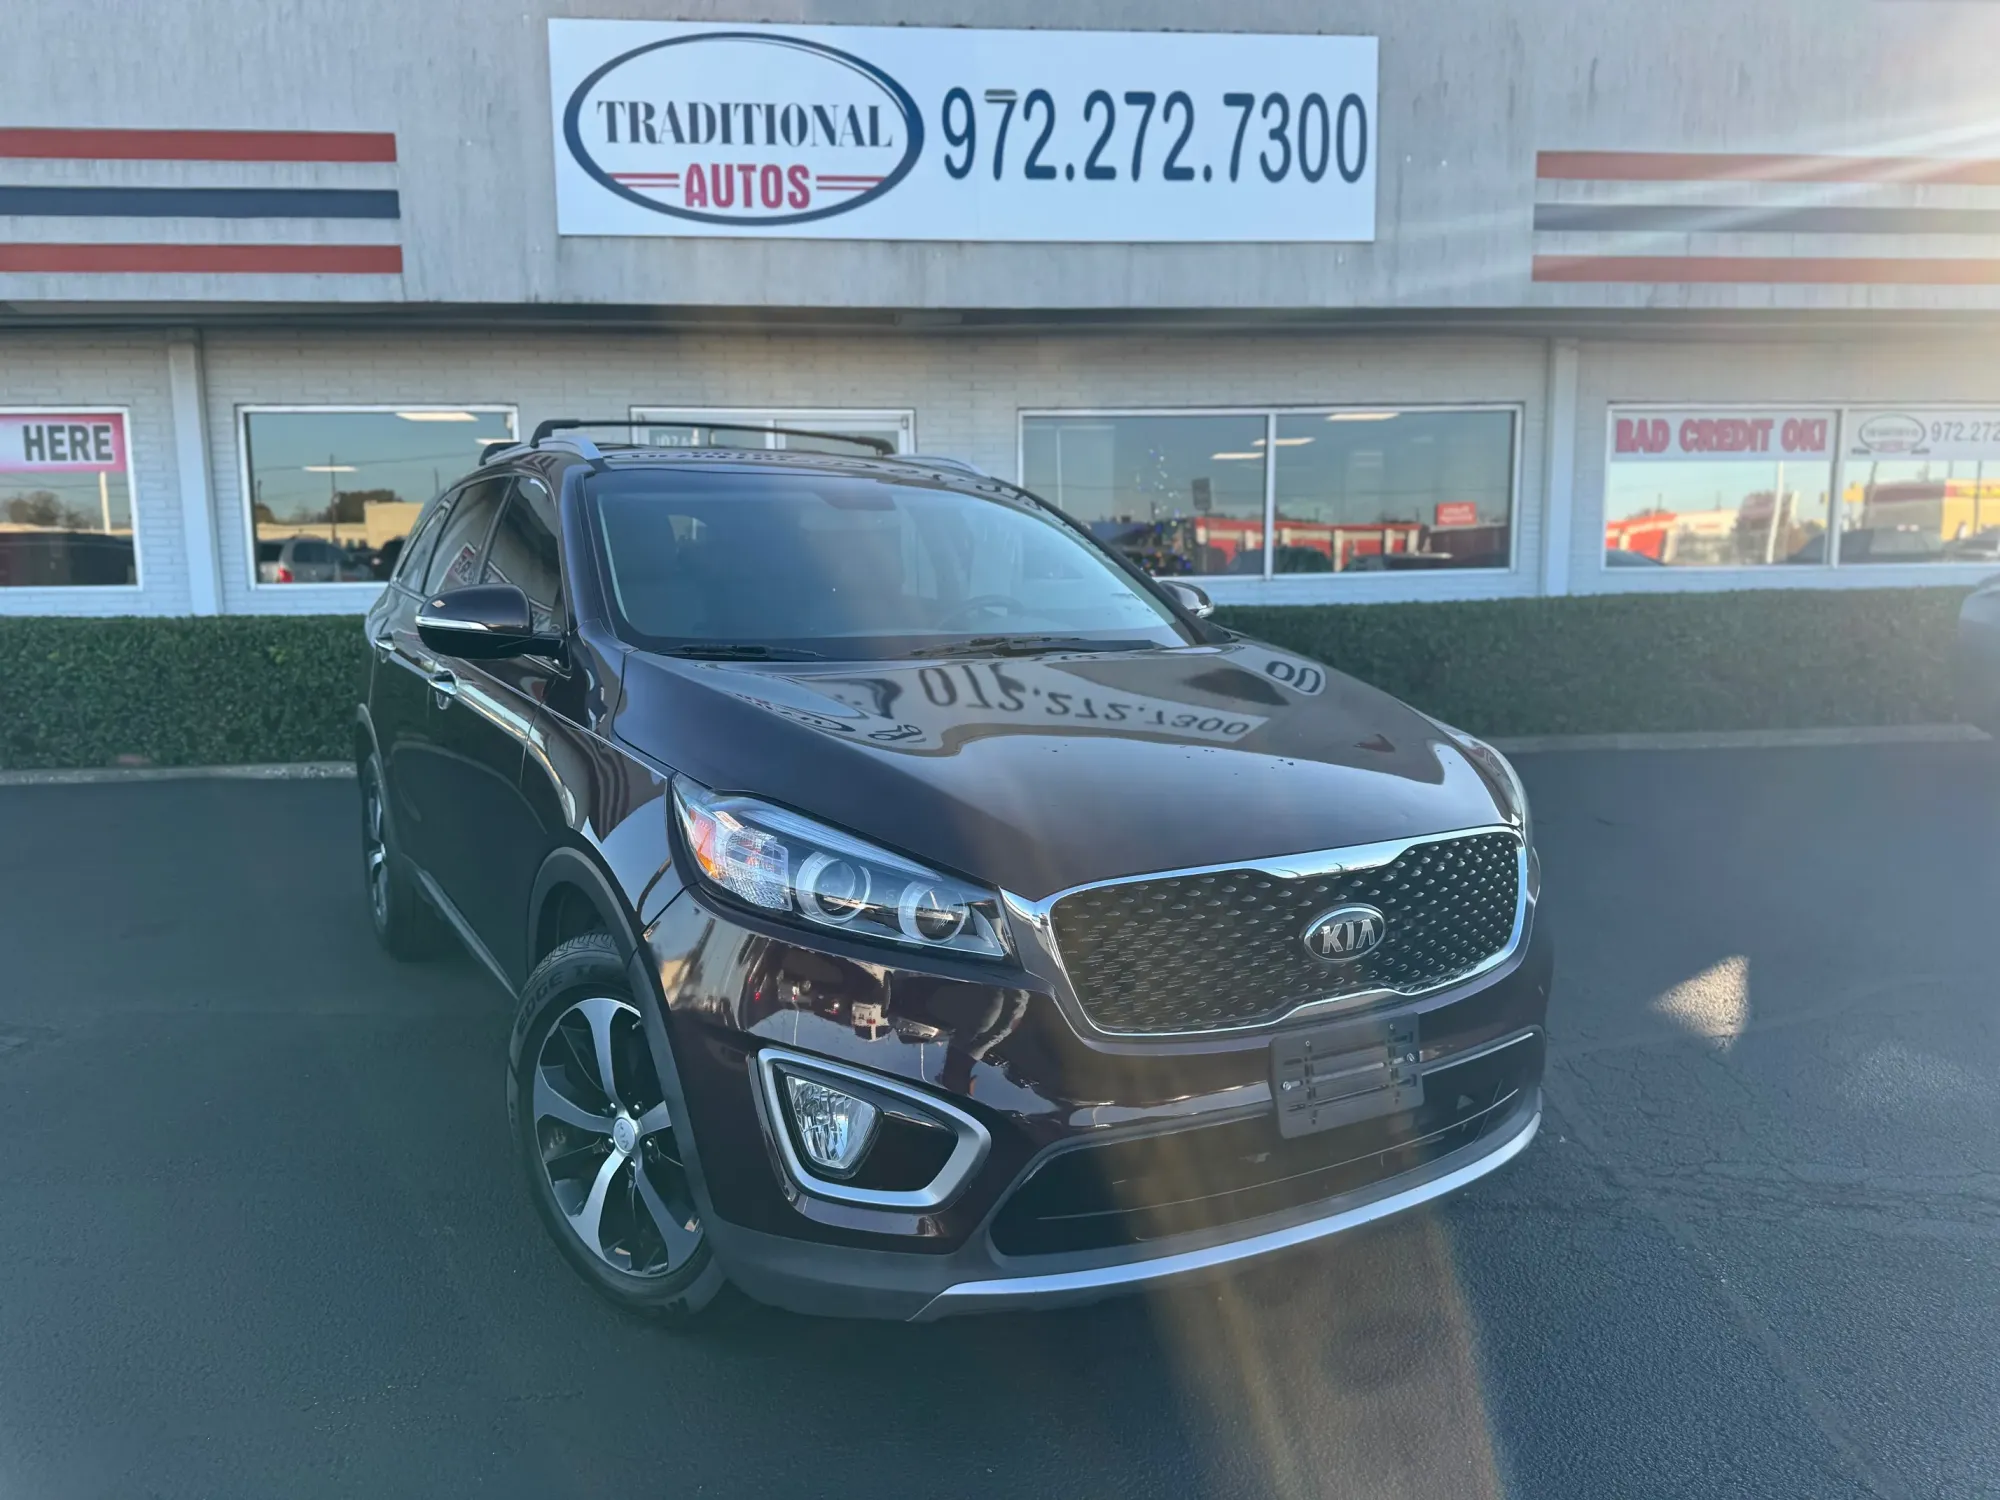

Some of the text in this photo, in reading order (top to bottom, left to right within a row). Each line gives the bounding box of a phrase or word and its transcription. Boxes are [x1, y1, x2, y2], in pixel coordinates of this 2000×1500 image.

[596, 99, 894, 148] TRADITIONAL
[941, 86, 1369, 184] 972.272.7300
[684, 162, 811, 210] AUTOS
[22, 424, 115, 462] HERE
[1615, 418, 1671, 454] BAD
[1679, 418, 1775, 454] CREDIT
[1321, 918, 1377, 955] KIA
